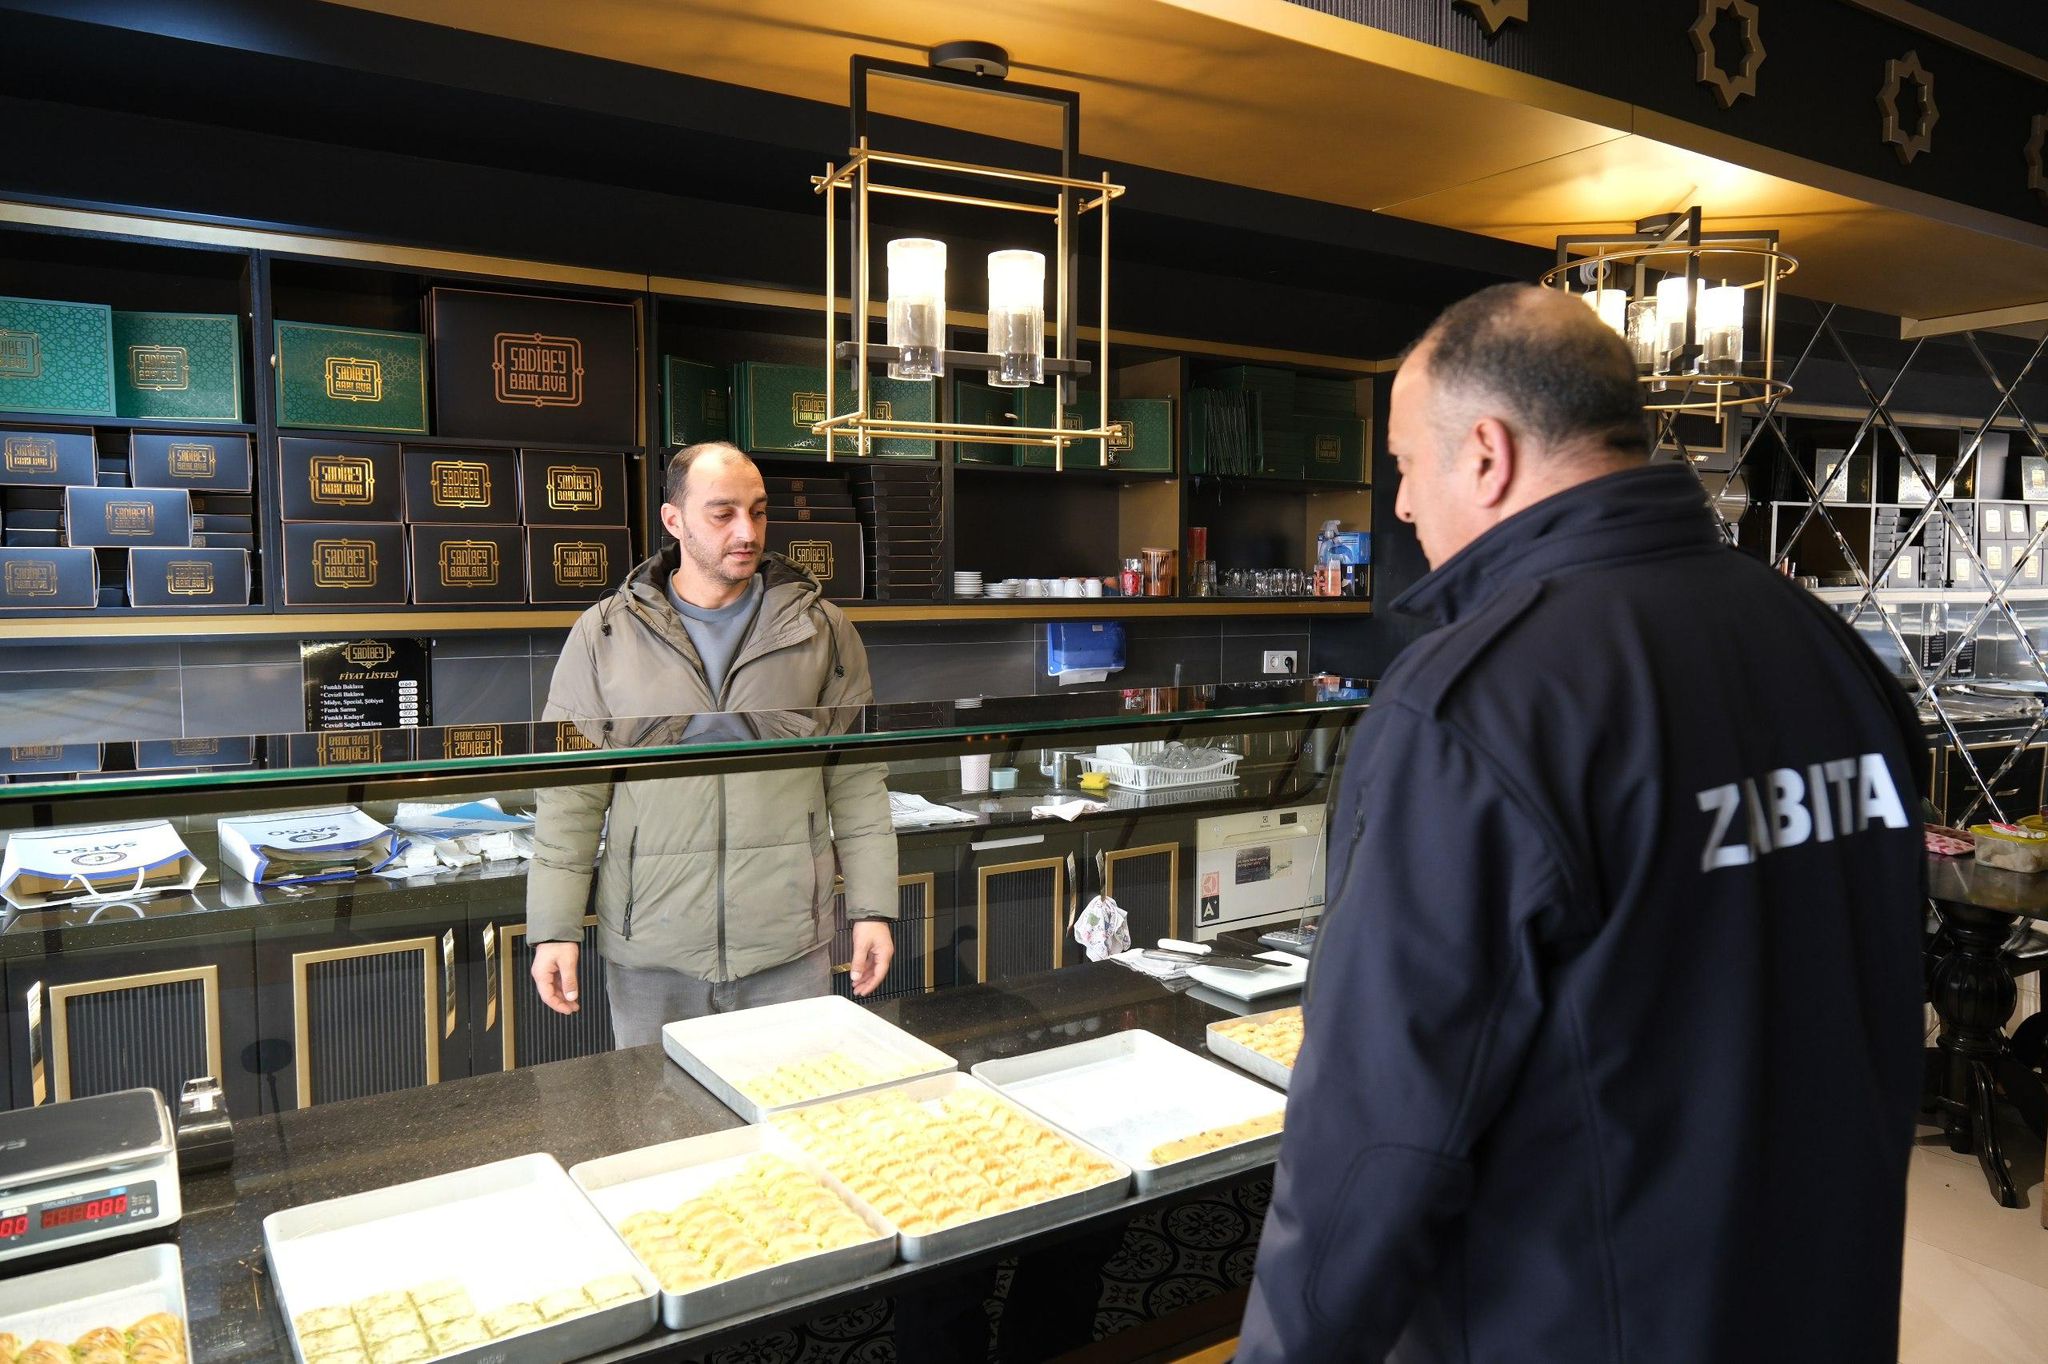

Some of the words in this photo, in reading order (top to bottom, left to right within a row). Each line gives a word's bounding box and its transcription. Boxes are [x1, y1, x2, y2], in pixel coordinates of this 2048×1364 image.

[510, 346, 566, 374] SADİBEY
[336, 364, 371, 381] SADİBEY
[336, 382, 372, 393] BAKLAVA
[510, 374, 568, 392] BAKLAVA
[321, 464, 362, 483] SADİBEY
[443, 468, 480, 487] SADİBEY
[557, 473, 591, 490] SADİBEY
[321, 483, 362, 495] BAKLAVA
[442, 487, 480, 499] BAKLAVA
[557, 490, 592, 501] BAKLAVA
[325, 547, 365, 566] SADİBEY
[450, 547, 487, 565] SADİBEY
[563, 549, 597, 566] SADİBEY
[797, 547, 825, 562] SADİBEY
[325, 566, 366, 578] BAKLAVA
[450, 566, 488, 577] BAKLAVA
[563, 566, 598, 577] BAKLAVA
[352, 646, 384, 659] SADİBEY
[340, 672, 364, 680] FİYAT
[365, 670, 398, 679] LİSTESİ
[131, 1207, 152, 1217] CAS
